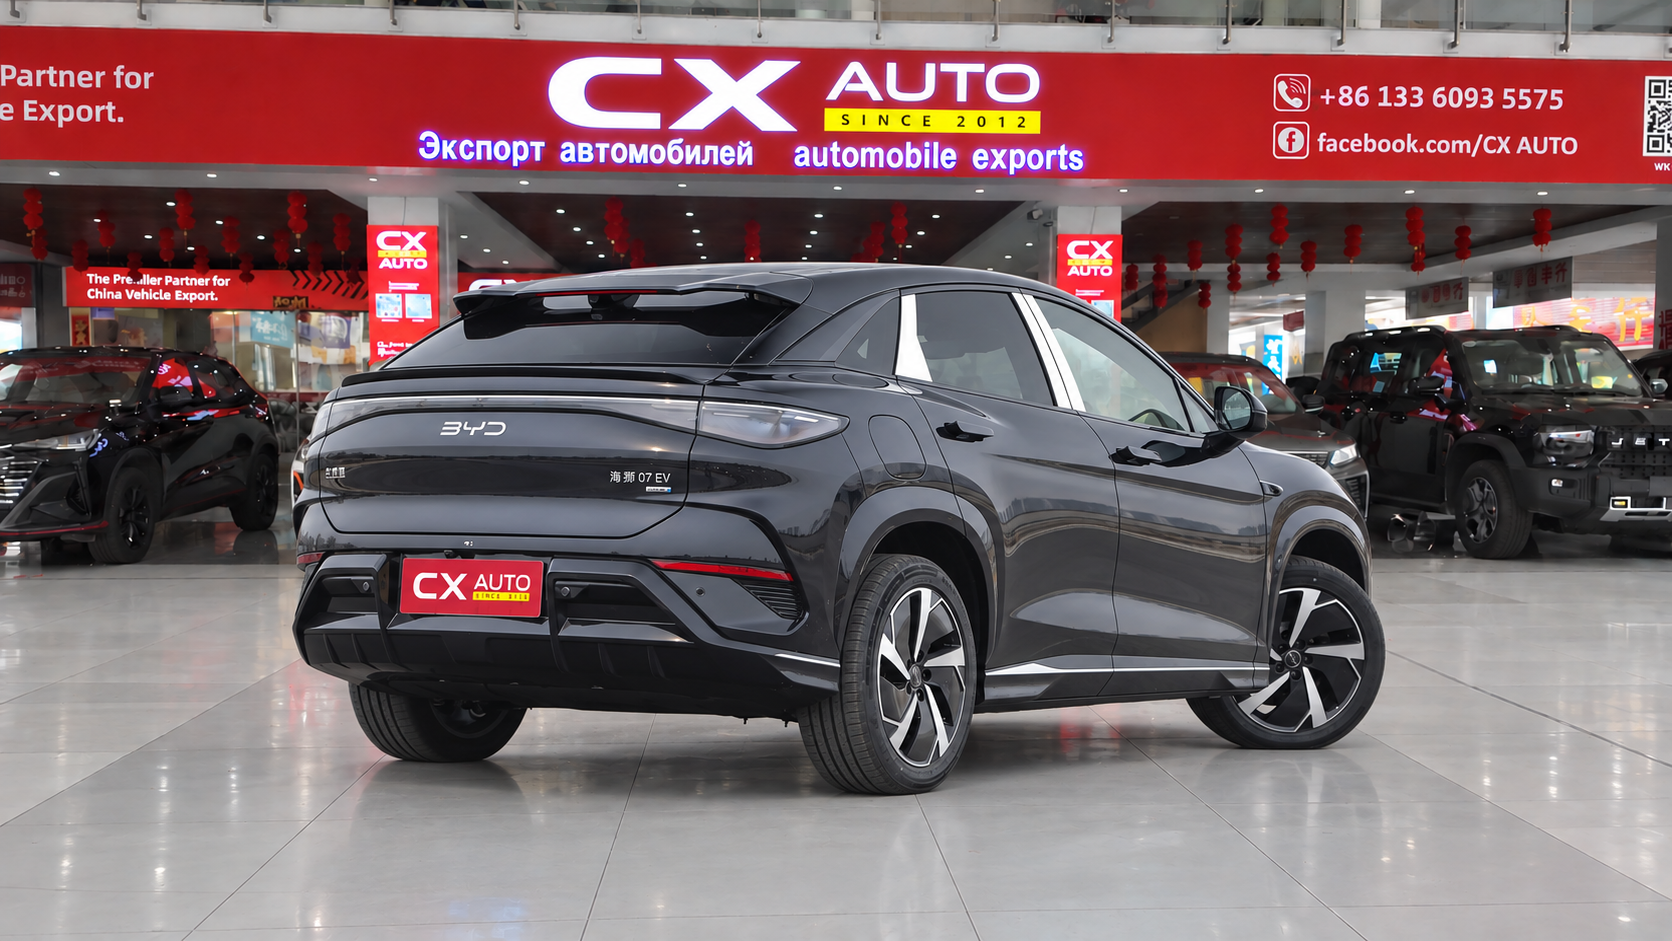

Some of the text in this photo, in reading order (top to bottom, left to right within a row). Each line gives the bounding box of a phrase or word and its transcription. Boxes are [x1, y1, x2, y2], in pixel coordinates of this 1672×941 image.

[0, 64, 154, 89] Partner for
[548, 57, 1041, 131] CX AUTO
[1320, 86, 1564, 110] +86 133 6093 5575
[23, 100, 124, 128] Export.
[841, 114, 1027, 128] SINCE 2012
[418, 131, 755, 167] Экспорт автомобилей
[1317, 133, 1578, 157] facebook.com/CX AUTO
[793, 141, 1085, 175] automobile exports
[376, 231, 427, 251] CX
[1066, 240, 1114, 260] CX
[378, 258, 428, 270] AUTO
[1067, 265, 1113, 276] AUTO
[86, 273, 110, 285] The
[165, 275, 211, 287] Partner
[212, 275, 231, 287] for
[86, 288, 219, 303] China Vehicle Export.
[440, 421, 507, 437] BYD
[609, 470, 671, 484] 海狮 07 EV
[412, 572, 532, 601] CX AUTO
